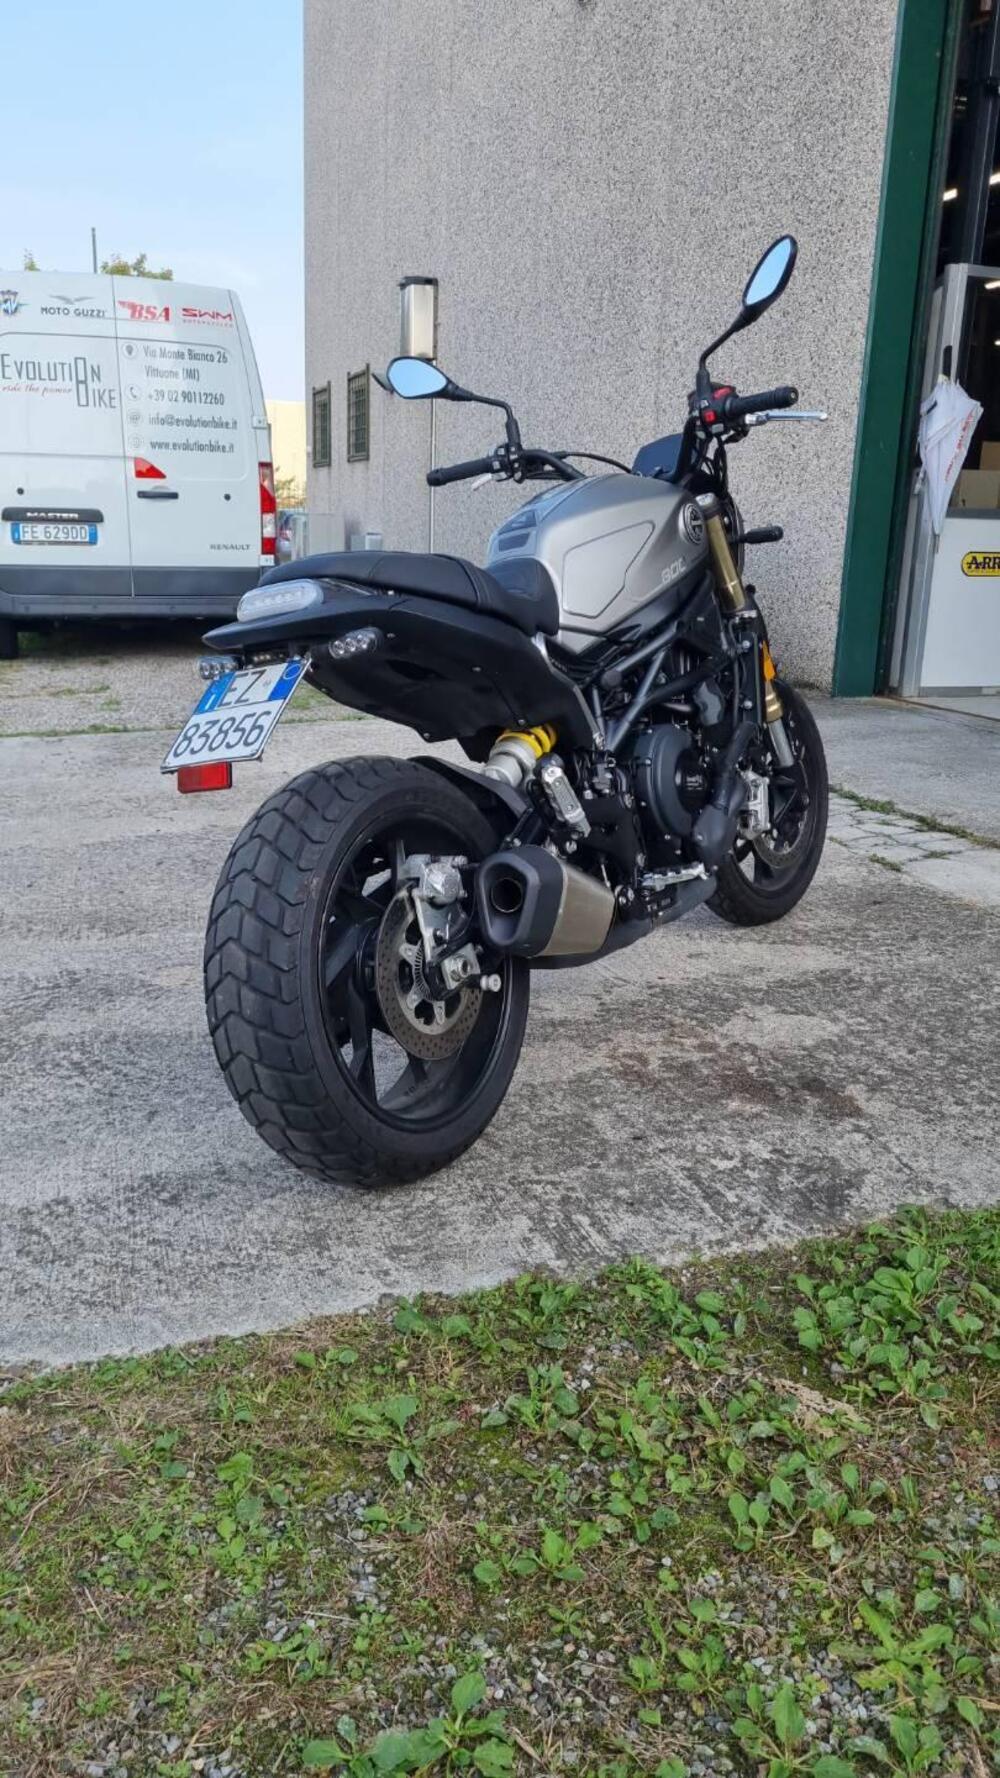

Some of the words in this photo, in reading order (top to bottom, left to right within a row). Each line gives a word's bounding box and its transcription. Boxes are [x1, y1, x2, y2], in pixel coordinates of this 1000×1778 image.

[40, 306, 70, 316] MOTO
[73, 307, 105, 318] GUZZI
[127, 302, 170, 322] BSA
[181, 307, 233, 321] SWM
[143, 345, 157, 358] Via
[159, 346, 185, 361] Monte
[187, 348, 215, 363] Bianco
[216, 350, 229, 364] 26
[144, 364, 180, 379] Vittuone
[182, 367, 200, 382] (MI)
[148, 388, 165, 402] +39
[167, 389, 179, 402] 02
[181, 390, 225, 406] 90112260
[148, 411, 238, 430] info@evolutionbike.it
[149, 438, 234, 453] www.evolutionbike.it
[26, 511, 79, 519] MASTER
[22, 525, 39, 539] FE
[209, 543, 251, 551] RENAULT
[217, 669, 268, 707] EZ
[173, 711, 272, 758] 83856
